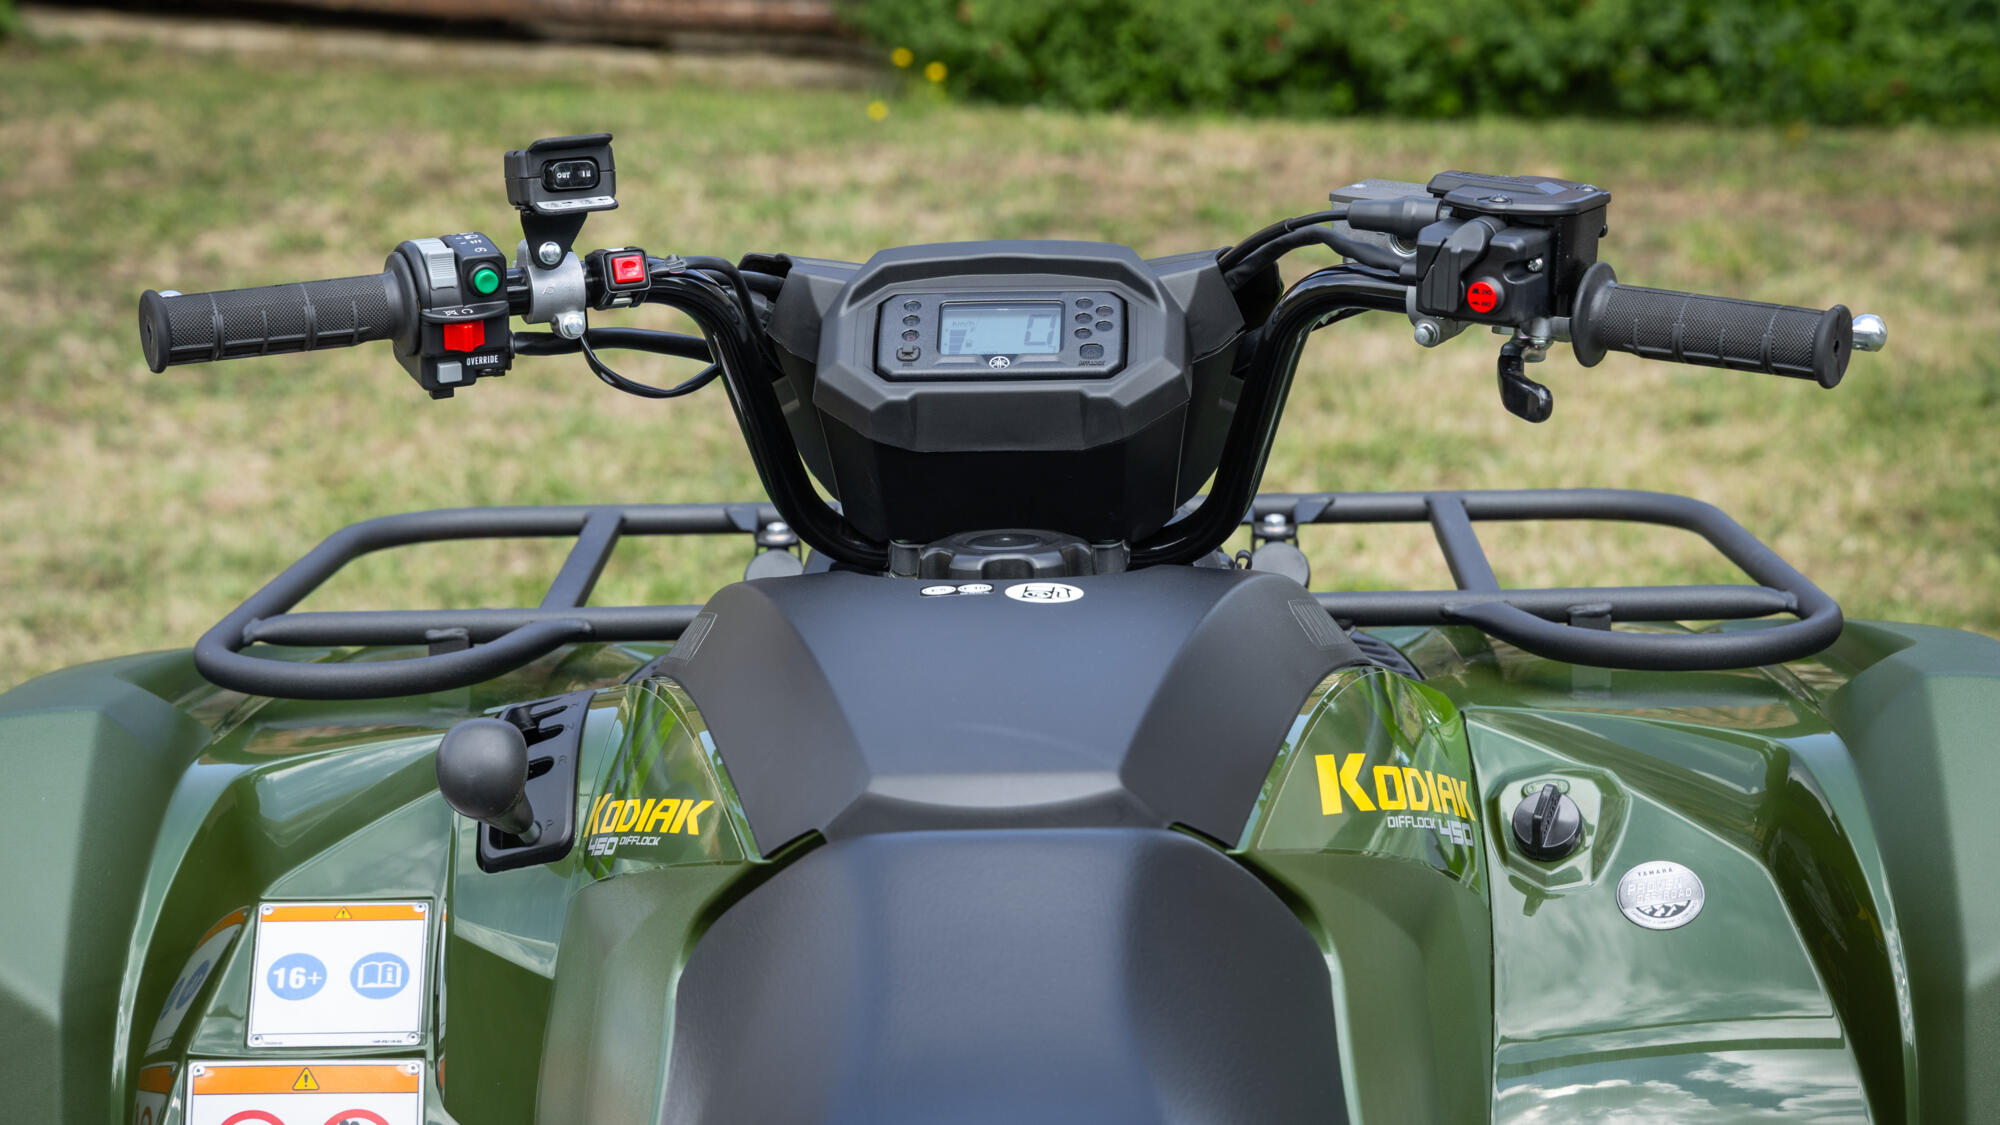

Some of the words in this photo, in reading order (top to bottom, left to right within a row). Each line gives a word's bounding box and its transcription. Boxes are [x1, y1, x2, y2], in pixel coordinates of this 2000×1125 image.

[557, 171, 571, 179] OUT
[1024, 313, 1057, 346] 0
[466, 355, 499, 366] OVERRIDE
[1315, 753, 1476, 821] KODIAK
[583, 793, 715, 838] KODIAK
[1387, 816, 1437, 829] DIFFLOCK
[1438, 820, 1474, 847] 450
[588, 836, 618, 856] 450
[619, 836, 661, 846] DIFFLOCK
[1637, 867, 1673, 876] YAMAHA
[273, 966, 323, 990] 16+
